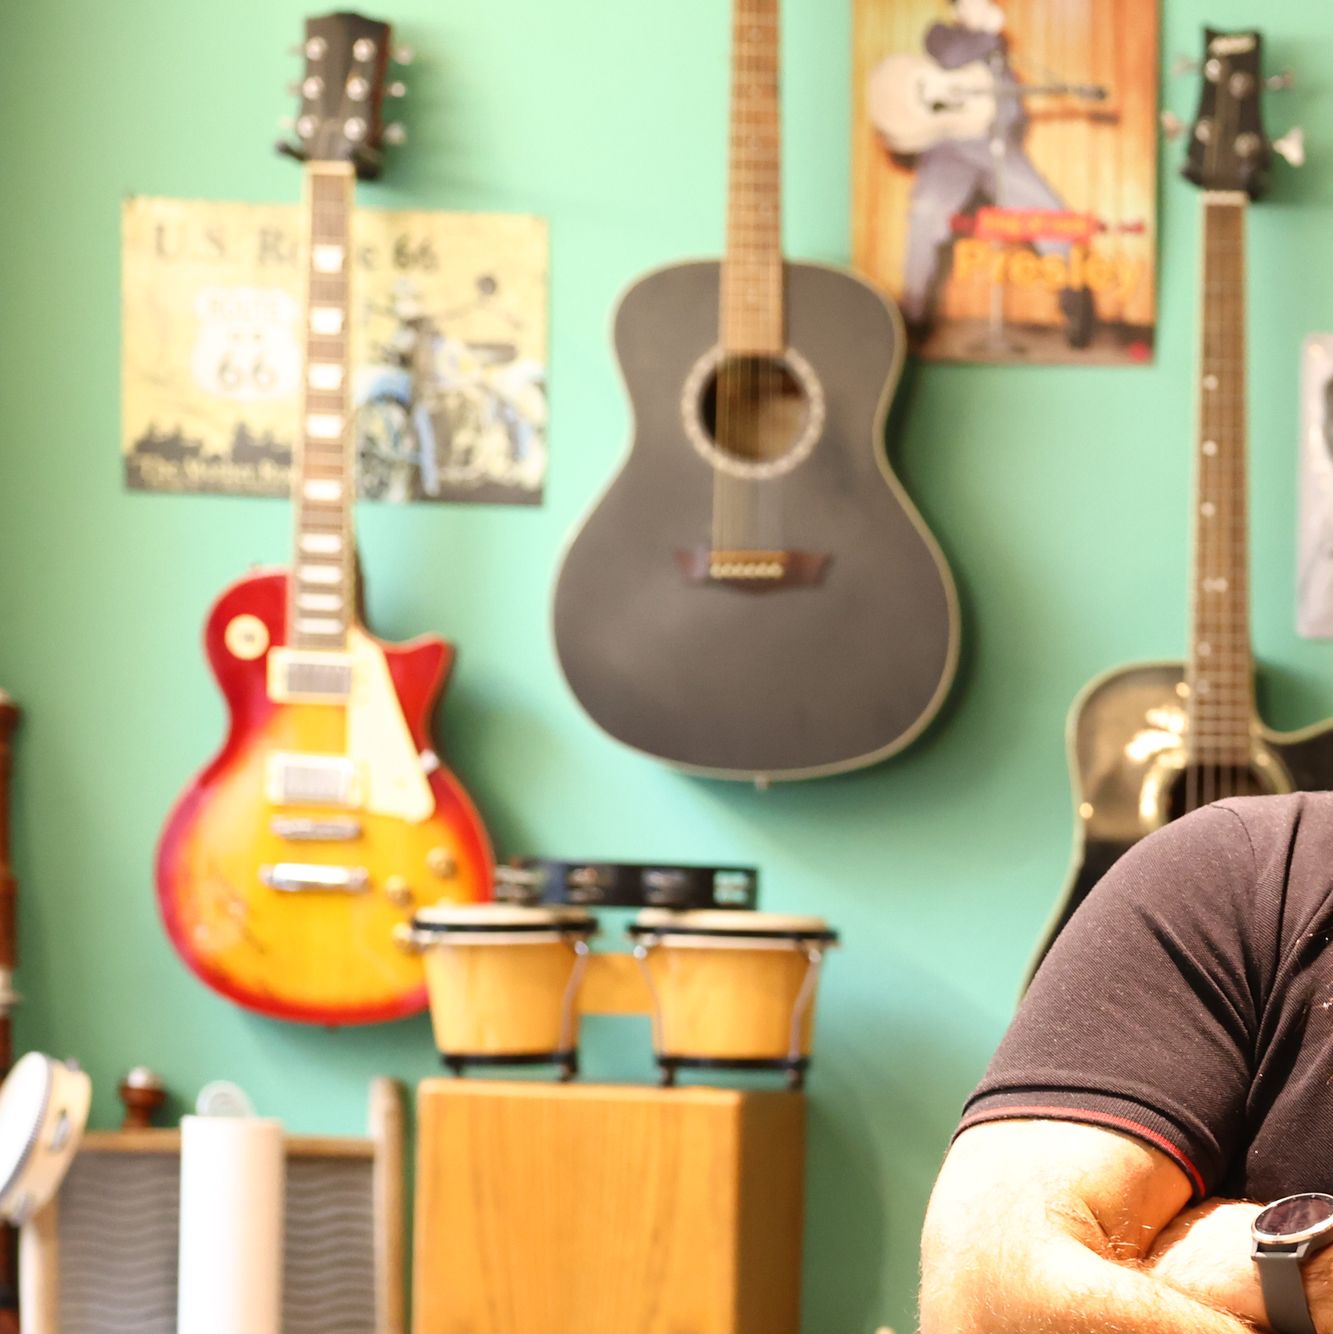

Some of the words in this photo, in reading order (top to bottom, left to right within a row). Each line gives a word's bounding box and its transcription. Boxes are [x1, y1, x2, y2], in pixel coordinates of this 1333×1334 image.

[393, 232, 441, 272] 66
[953, 238, 1140, 295] Presley
[217, 351, 279, 391] 66
